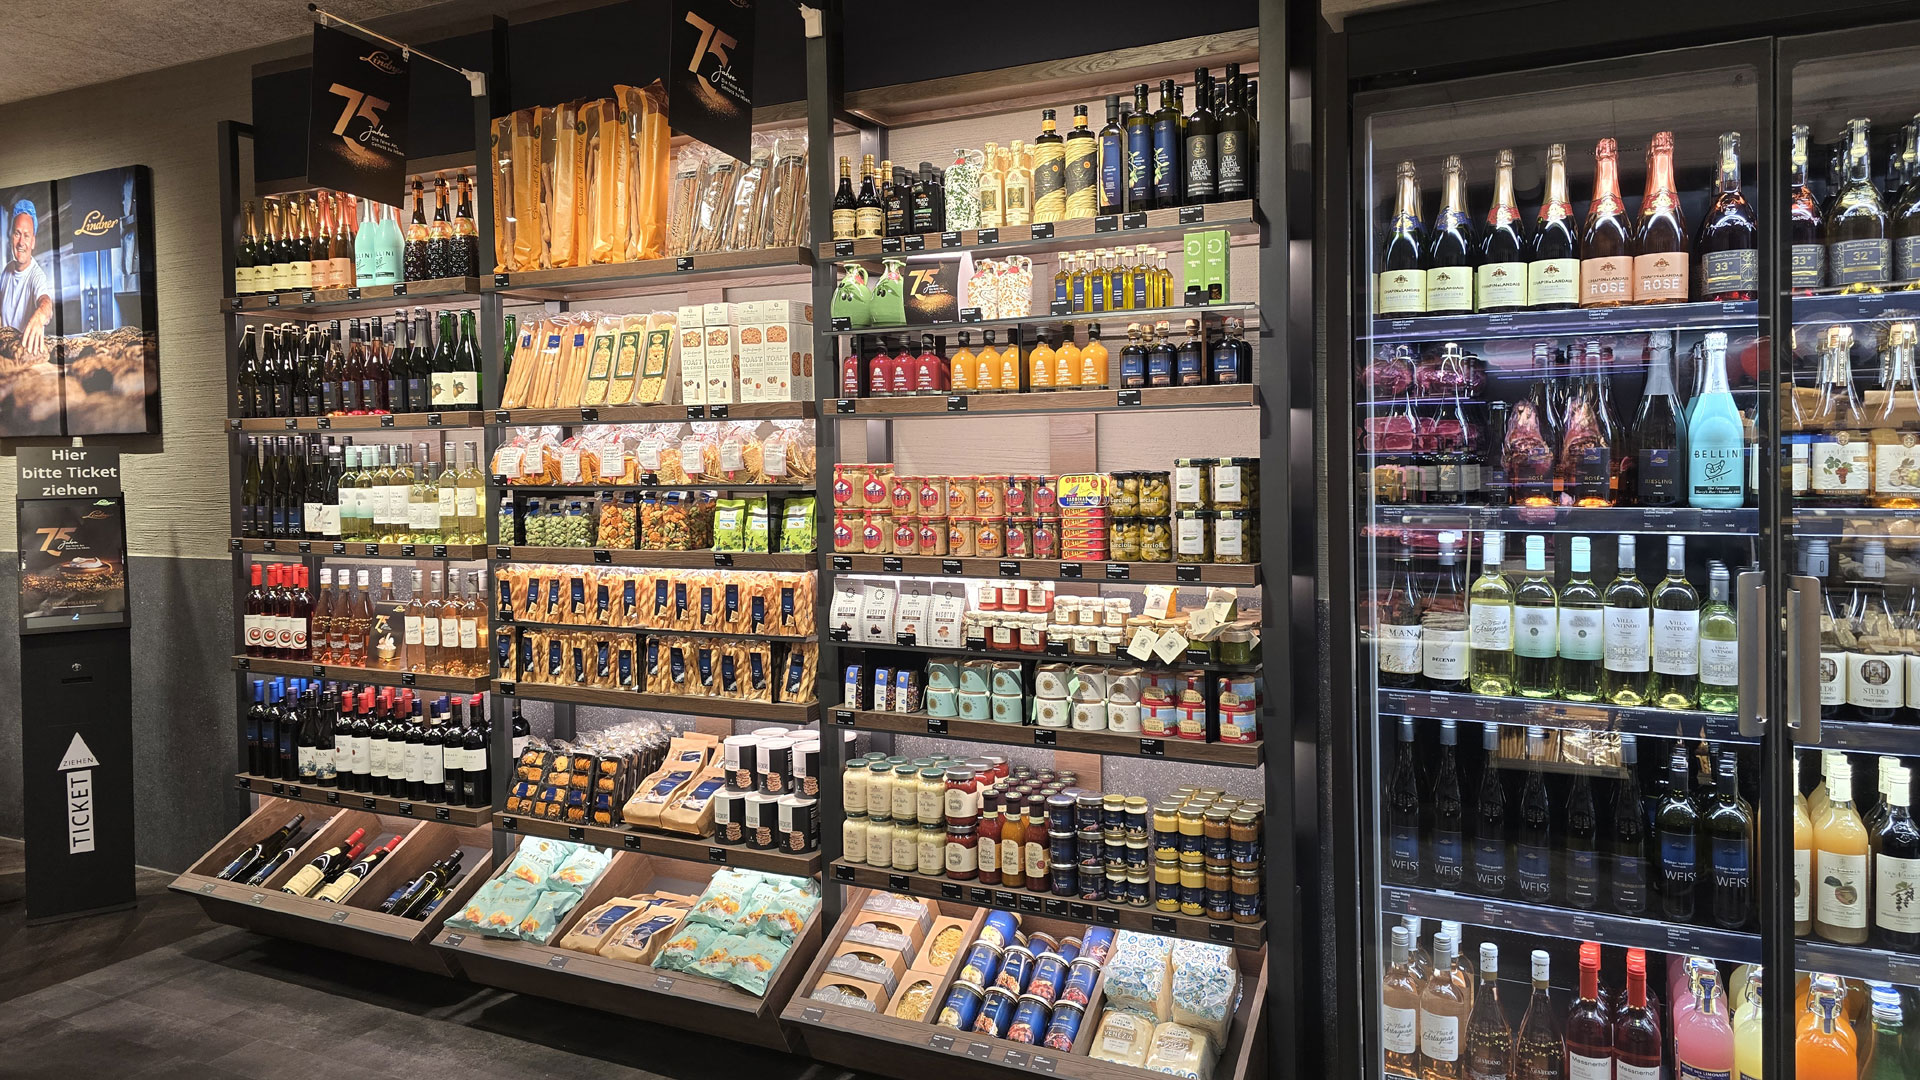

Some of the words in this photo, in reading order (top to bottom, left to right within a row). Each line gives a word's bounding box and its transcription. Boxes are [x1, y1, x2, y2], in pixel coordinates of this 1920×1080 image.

[685, 11, 738, 99] 75
[328, 82, 391, 157] 75
[359, 124, 390, 142] Jahre
[74, 210, 119, 236] Lindner
[909, 269, 939, 300] 75
[52, 449, 87, 461] Hier
[22, 467, 62, 479] bitte
[66, 466, 117, 478] Ticket
[1065, 476, 1090, 484] ORTIZ
[42, 485, 98, 496] ziehen
[36, 527, 77, 557] 75
[1862, 687, 1889, 695] STUDIO
[63, 758, 94, 767] ZIEHEN
[70, 778, 91, 847] TICKET
[1572, 1056, 1608, 1067] Messnerhof
[1619, 1064, 1655, 1076] Messnerhof
